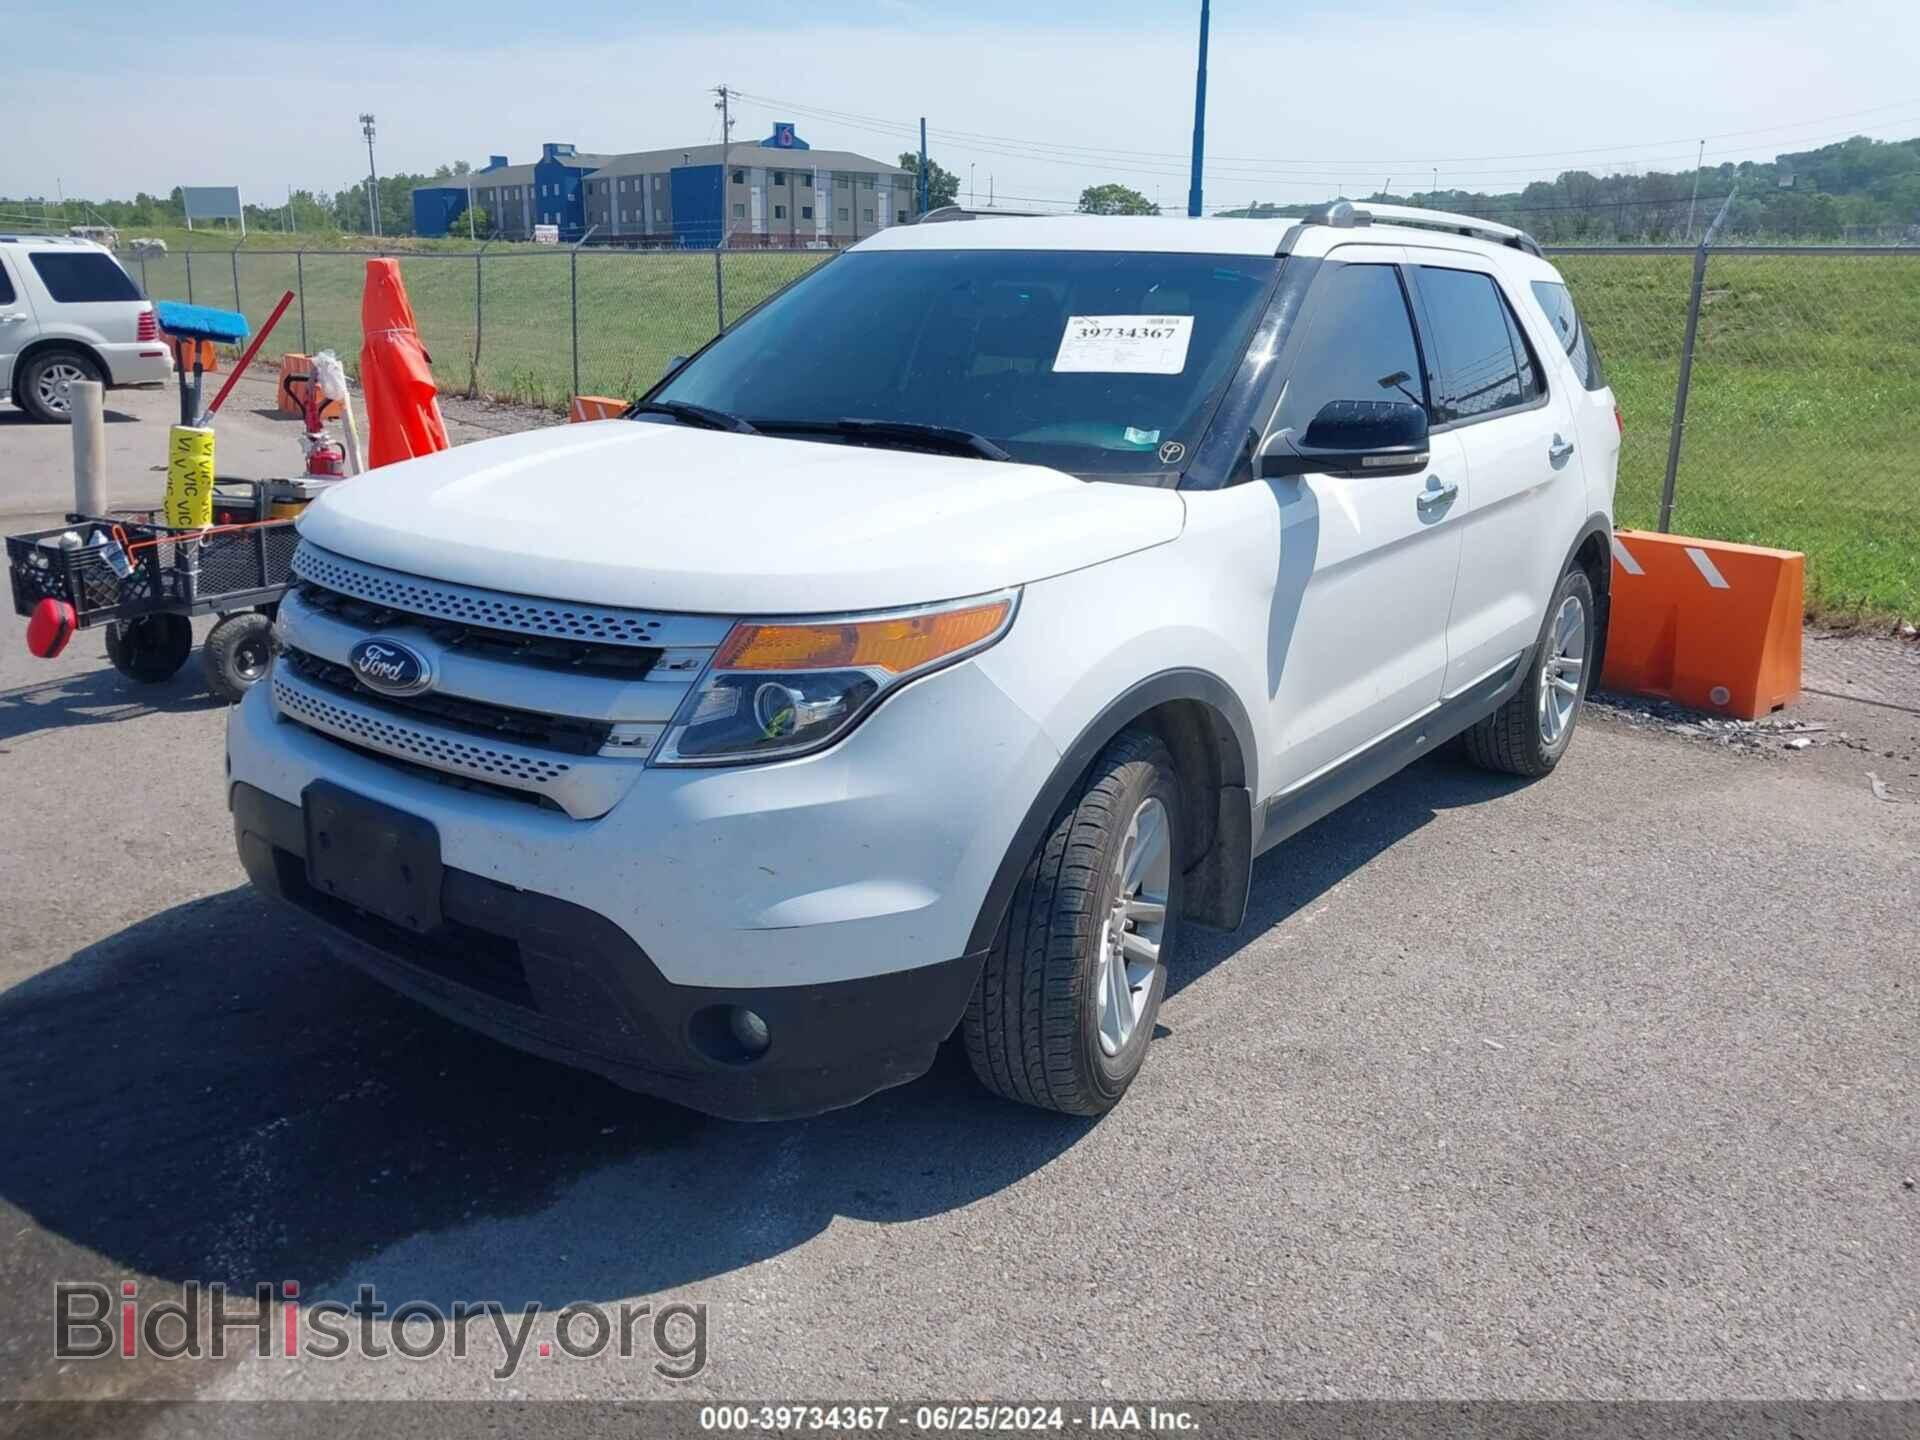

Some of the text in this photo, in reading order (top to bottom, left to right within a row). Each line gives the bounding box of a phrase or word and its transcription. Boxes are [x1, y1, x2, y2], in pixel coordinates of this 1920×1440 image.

[1076, 327, 1176, 340] 39734367
[183, 471, 198, 497] VIC
[176, 500, 193, 526] VIC
[359, 644, 406, 681] Ford
